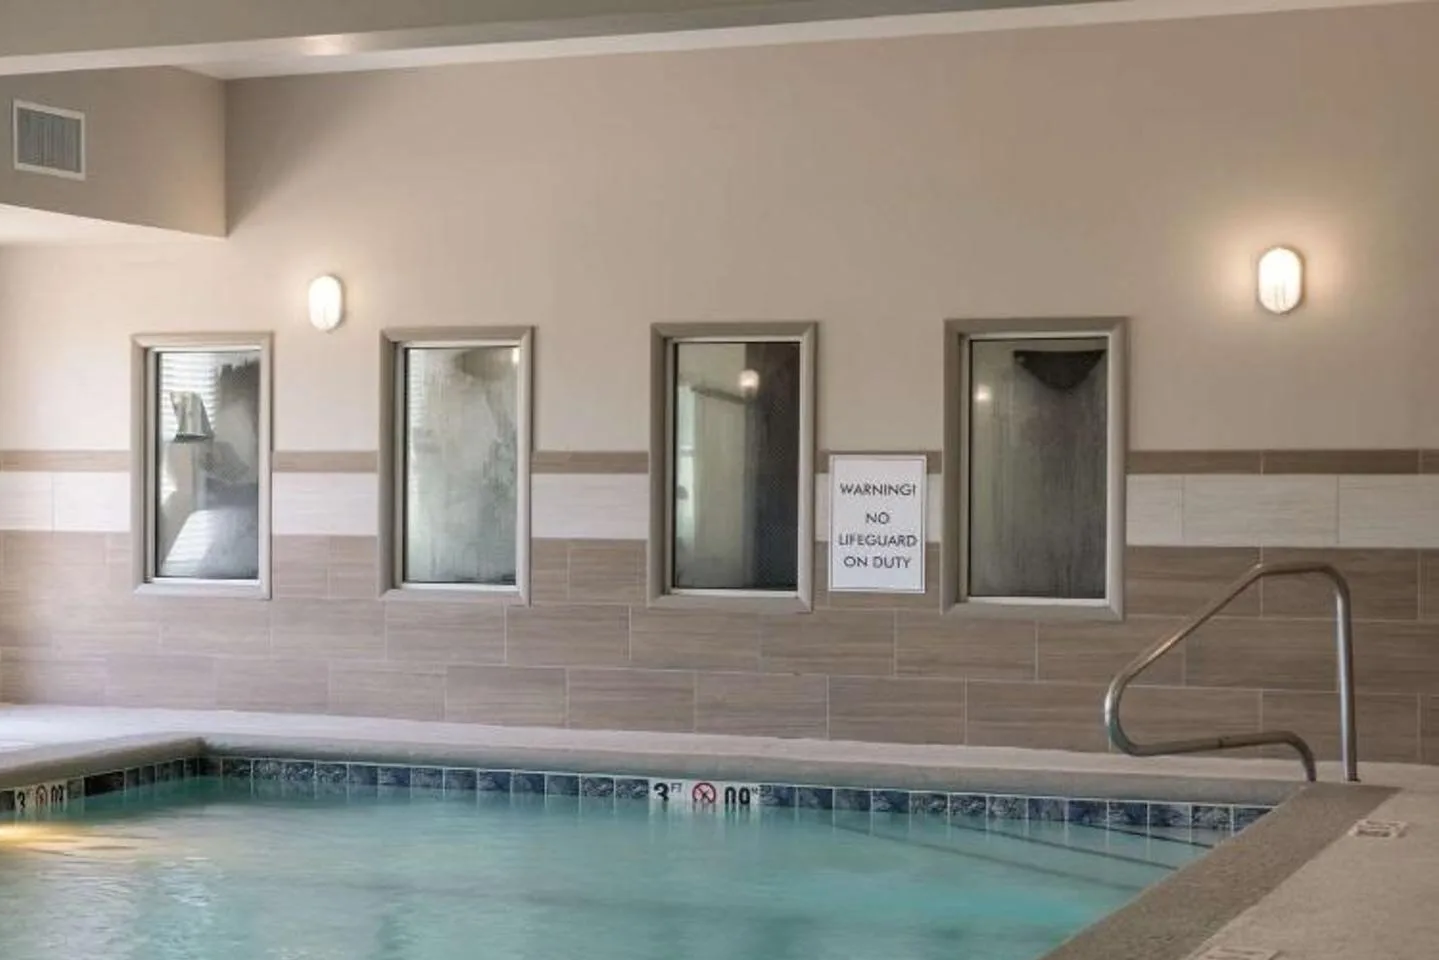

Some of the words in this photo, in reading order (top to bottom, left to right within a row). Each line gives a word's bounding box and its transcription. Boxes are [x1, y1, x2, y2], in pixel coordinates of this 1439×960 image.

[839, 483, 916, 496] WARNING!
[864, 511, 890, 525] NO
[838, 533, 918, 548] LIFEGUARD
[843, 555, 868, 568] ON
[872, 556, 912, 569] DUTY
